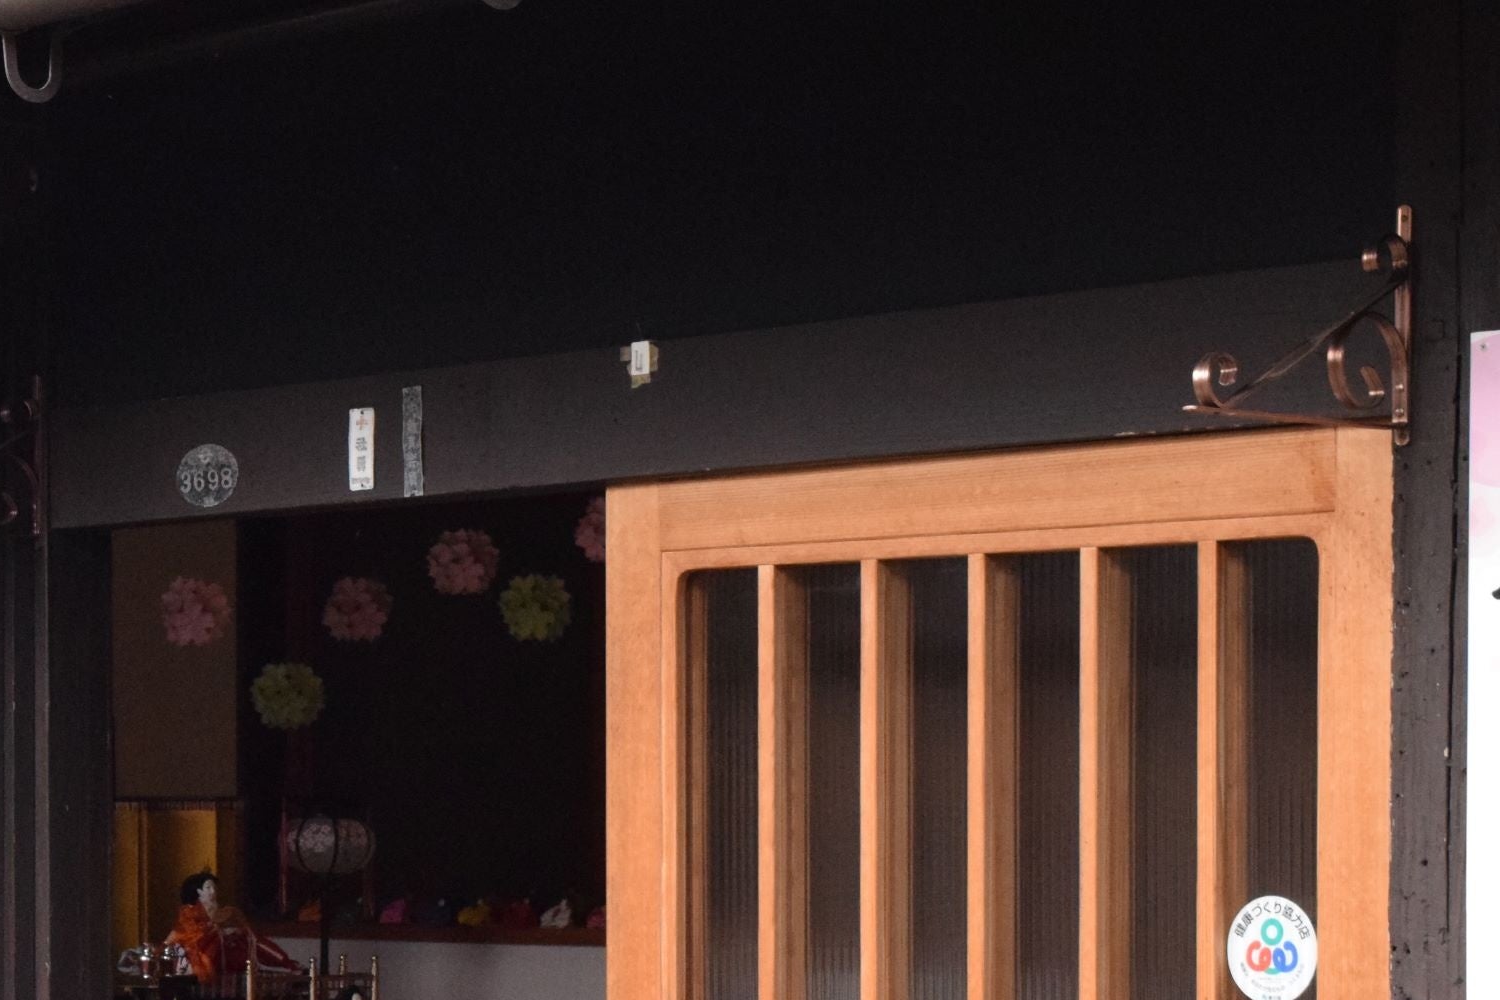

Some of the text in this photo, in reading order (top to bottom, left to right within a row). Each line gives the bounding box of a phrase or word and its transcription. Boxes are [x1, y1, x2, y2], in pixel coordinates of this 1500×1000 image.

[180, 467, 233, 493] 3698
[1234, 902, 1311, 940] 健康づくり協力店
